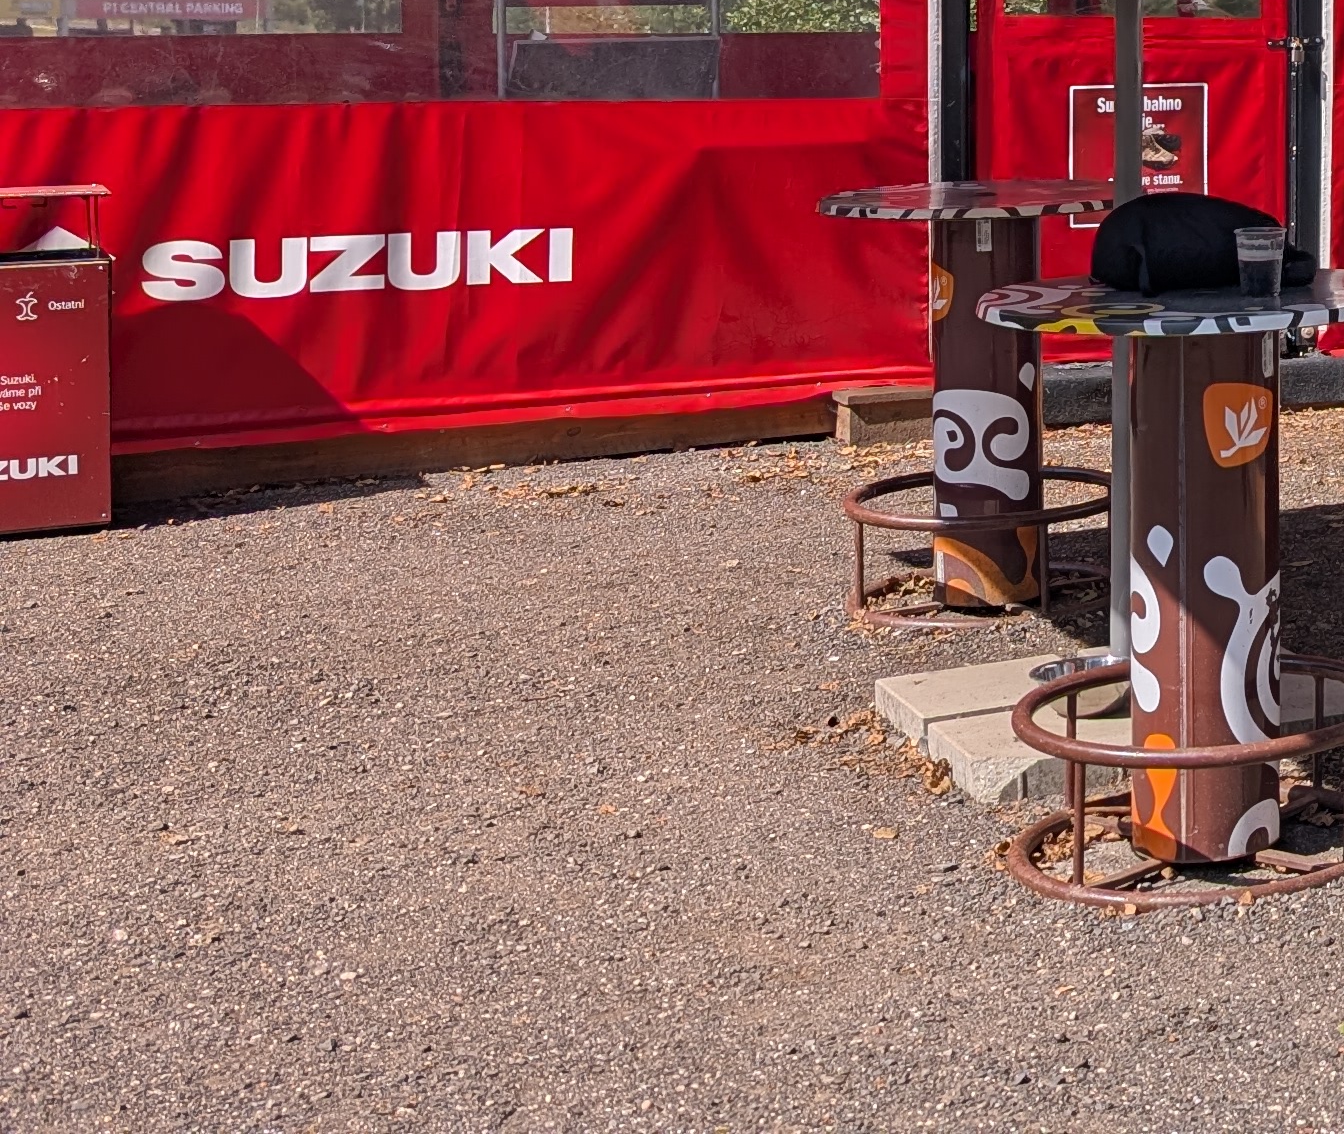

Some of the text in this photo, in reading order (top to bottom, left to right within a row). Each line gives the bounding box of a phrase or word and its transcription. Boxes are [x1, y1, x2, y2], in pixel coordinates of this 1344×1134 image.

[120, 2, 183, 14] CENTRAL
[185, 2, 244, 14] PARKING
[1143, 95, 1182, 112] bahno
[1153, 173, 1184, 186] stanu.
[141, 227, 574, 302] SUZUKI
[0, 373, 37, 386] Suzuki.
[13, 400, 37, 411] vozy
